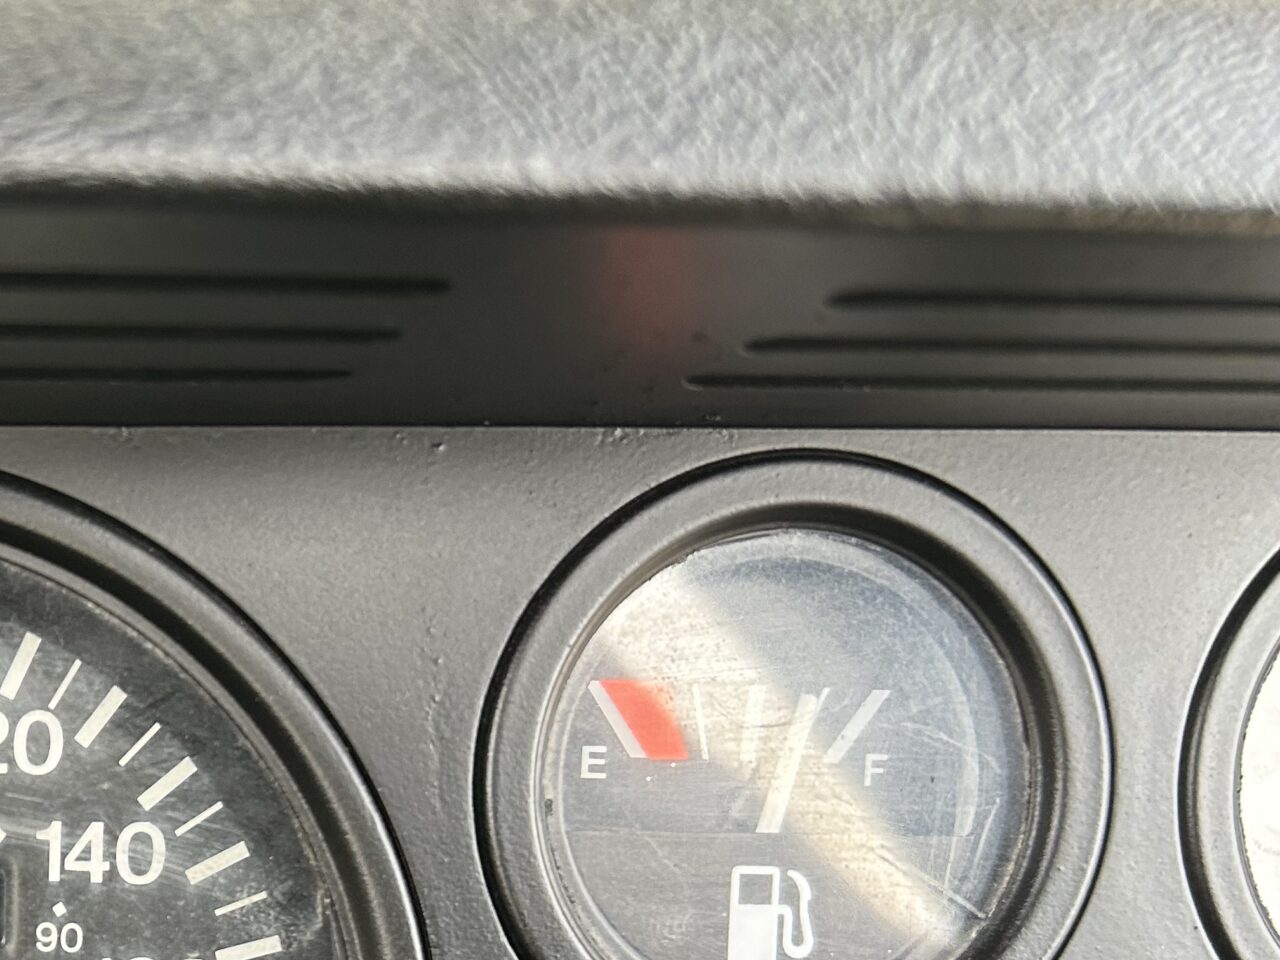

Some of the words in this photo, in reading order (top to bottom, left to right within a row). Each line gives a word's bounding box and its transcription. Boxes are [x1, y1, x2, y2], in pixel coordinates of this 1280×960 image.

[580, 746, 607, 780] E
[864, 755, 888, 786] F
[36, 821, 165, 885] 140
[35, 922, 83, 952] 90
